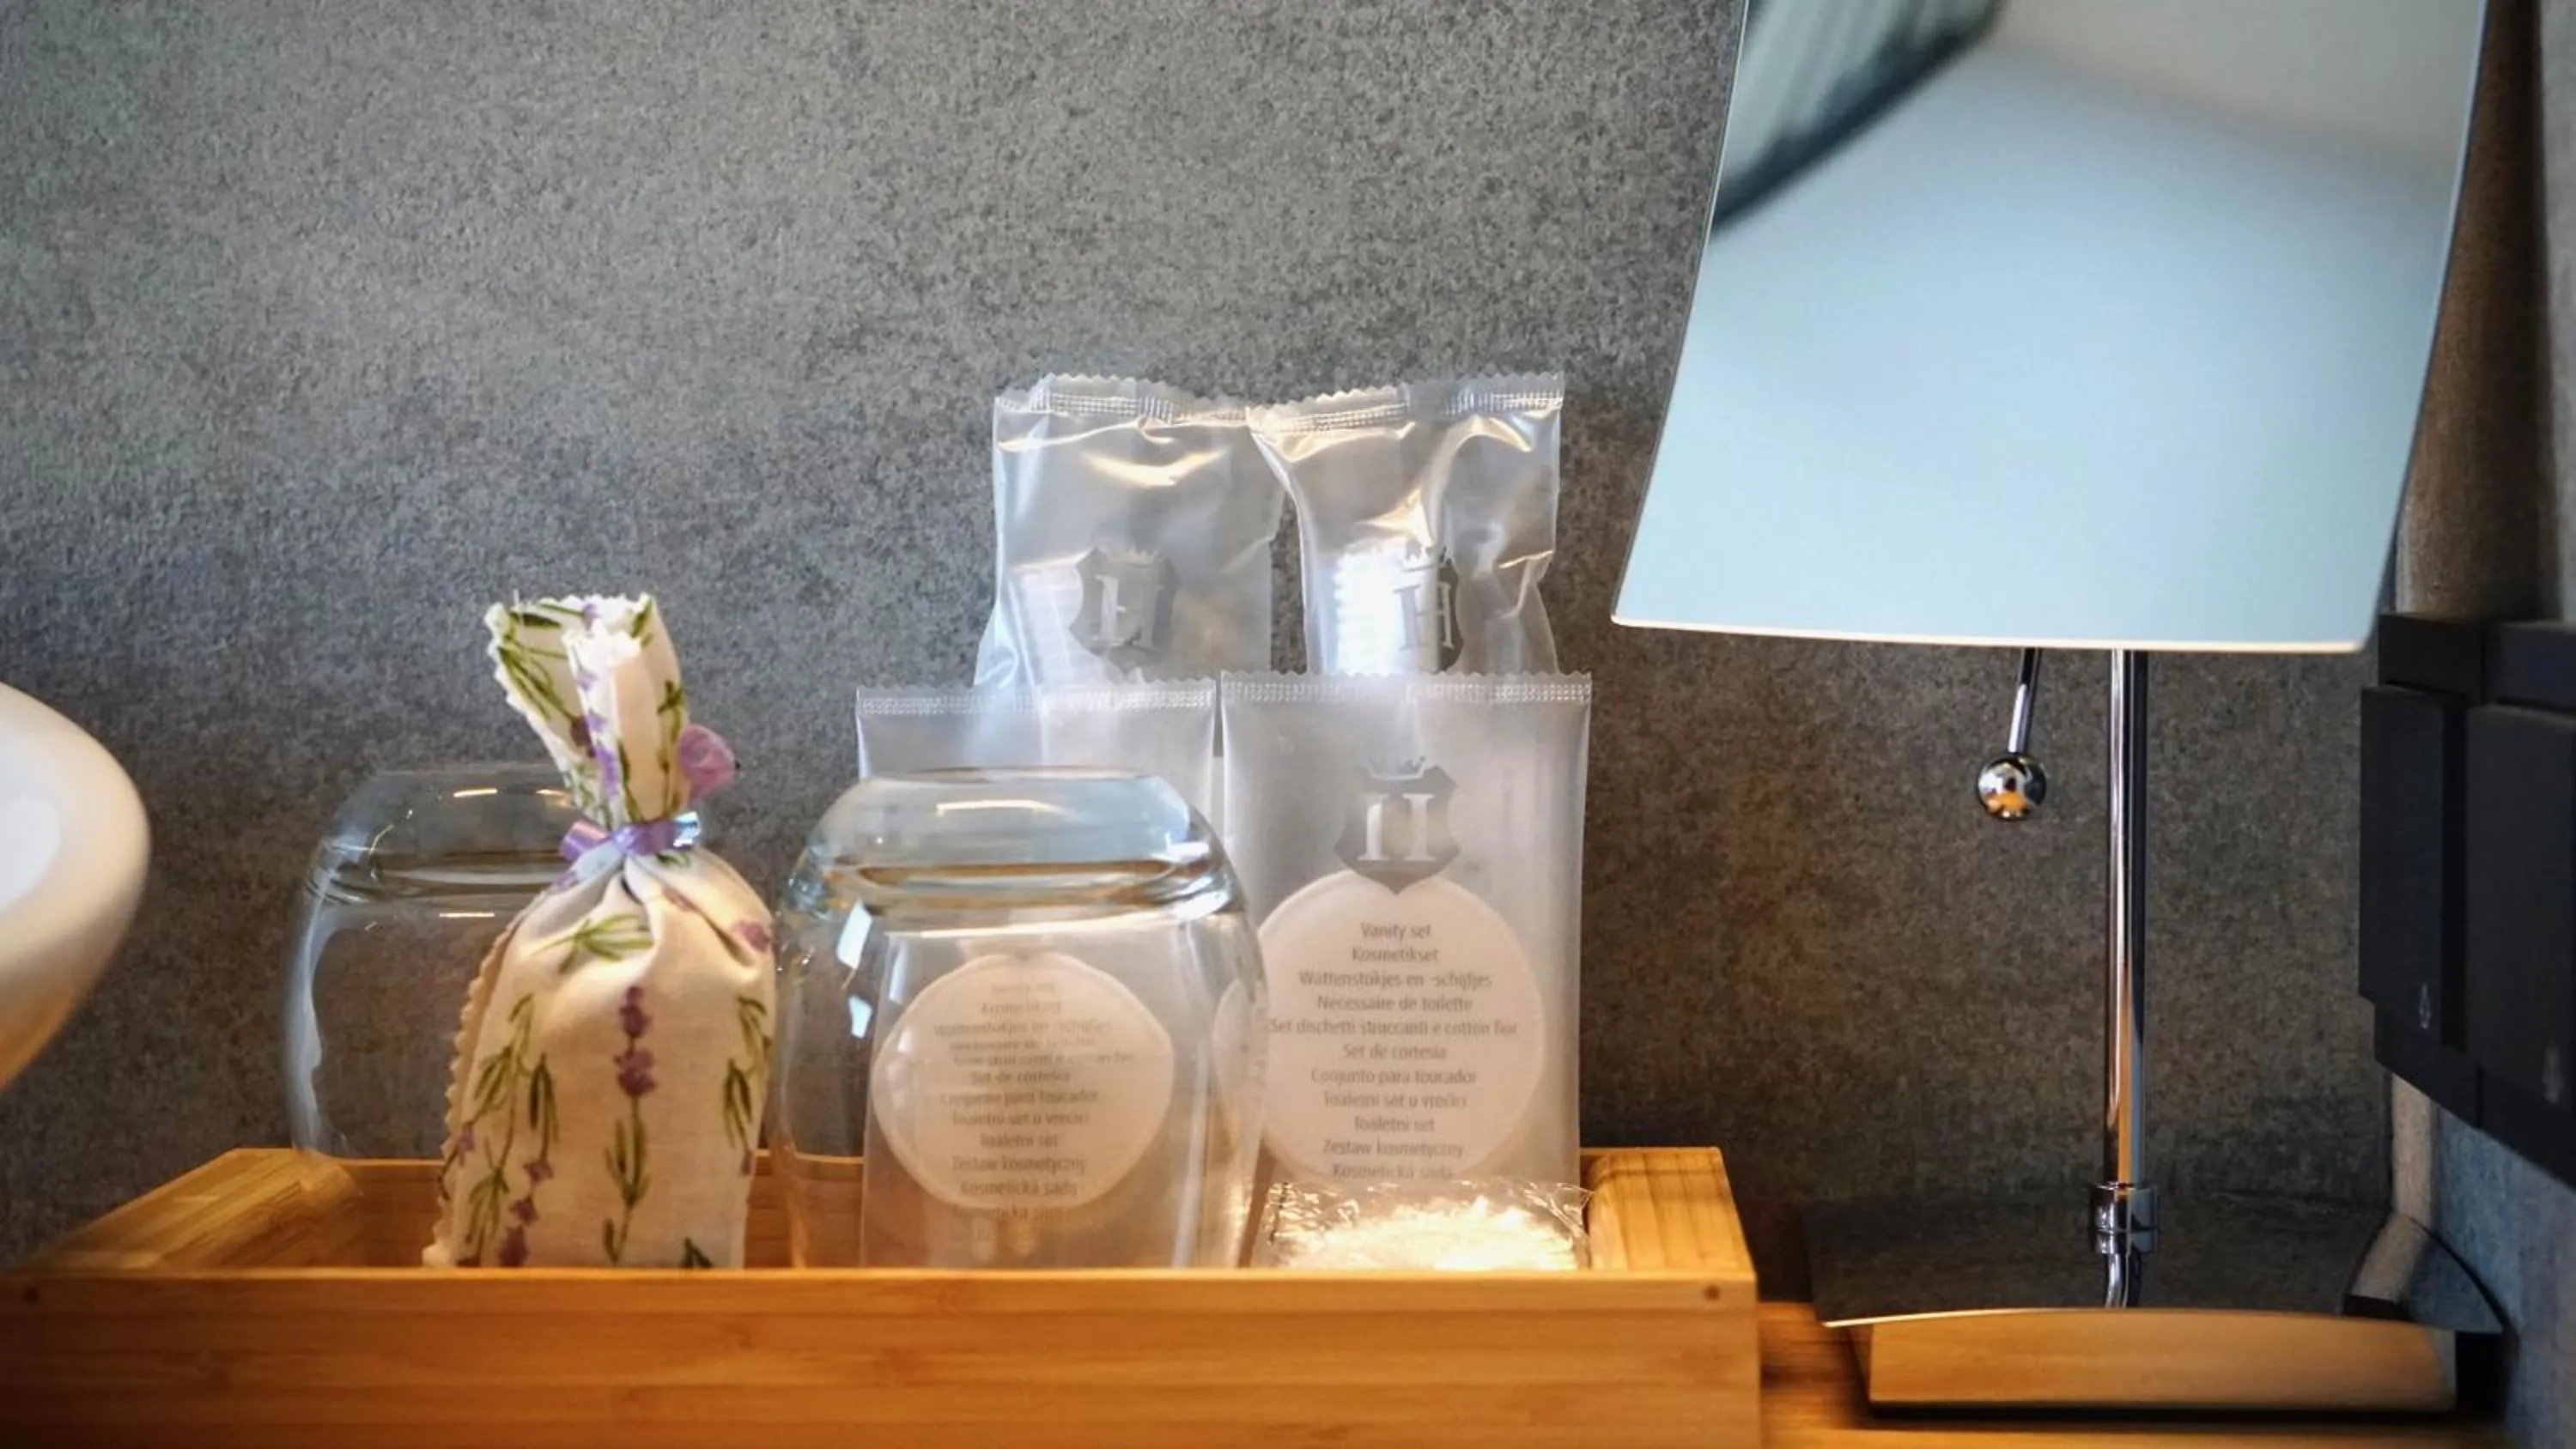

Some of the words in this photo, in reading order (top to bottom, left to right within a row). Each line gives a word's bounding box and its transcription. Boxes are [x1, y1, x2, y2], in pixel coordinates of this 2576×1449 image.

[1360, 922, 1406, 942] Vanity
[1410, 924, 1431, 939] set
[1352, 947, 1440, 963] Kosmetikset
[1406, 975, 1425, 987] en
[1317, 995, 1395, 1011] Necessaire
[1399, 997, 1417, 1011] de
[1422, 997, 1473, 1012] toilette
[1269, 1018, 1293, 1034] Set
[1343, 1043, 1365, 1059] Set
[1370, 1043, 1388, 1059] de
[1311, 1068, 1376, 1086] Conjunto
[1378, 1070, 1411, 1086] para
[1415, 1069, 1476, 1084] toucador
[1383, 1094, 1404, 1107] set
